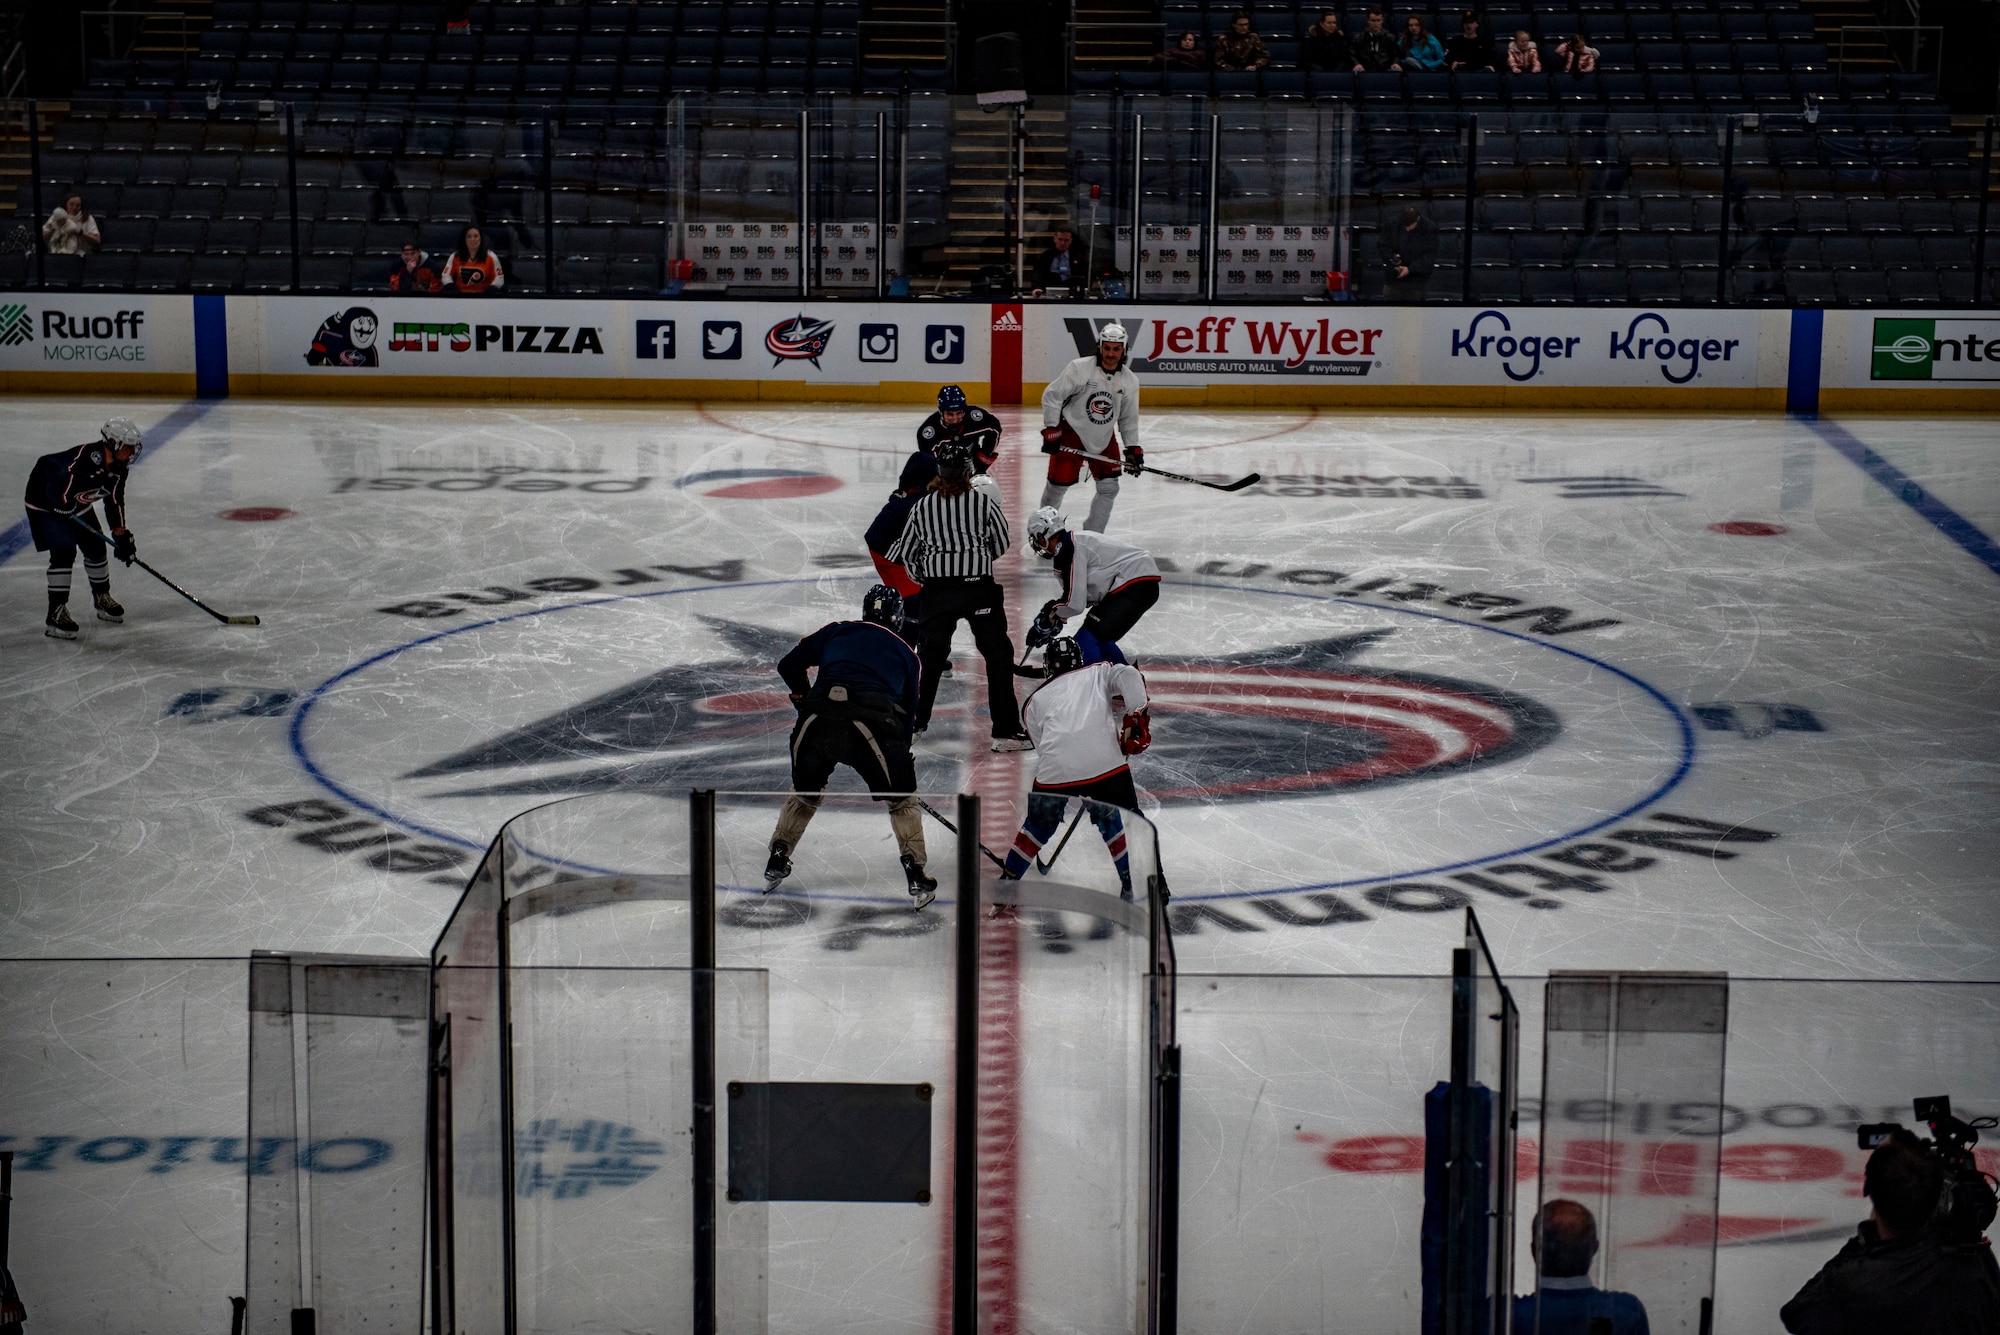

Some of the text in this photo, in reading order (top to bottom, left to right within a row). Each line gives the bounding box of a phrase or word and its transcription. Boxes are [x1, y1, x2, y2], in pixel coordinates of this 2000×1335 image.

[43, 311, 144, 339] Ruoff
[993, 323, 1022, 331] adidas
[389, 323, 604, 354] JET'S PIZZA
[1147, 317, 1383, 367] Jeff Wyler
[1452, 310, 1580, 381] Kroger
[1609, 313, 1738, 383] Kroger
[44, 345, 145, 361] MORTGAGE
[1158, 361, 1277, 374] COLUMBUS AUTO MALL
[1308, 364, 1362, 376] #wylerway
[332, 476, 652, 495] pepsi
